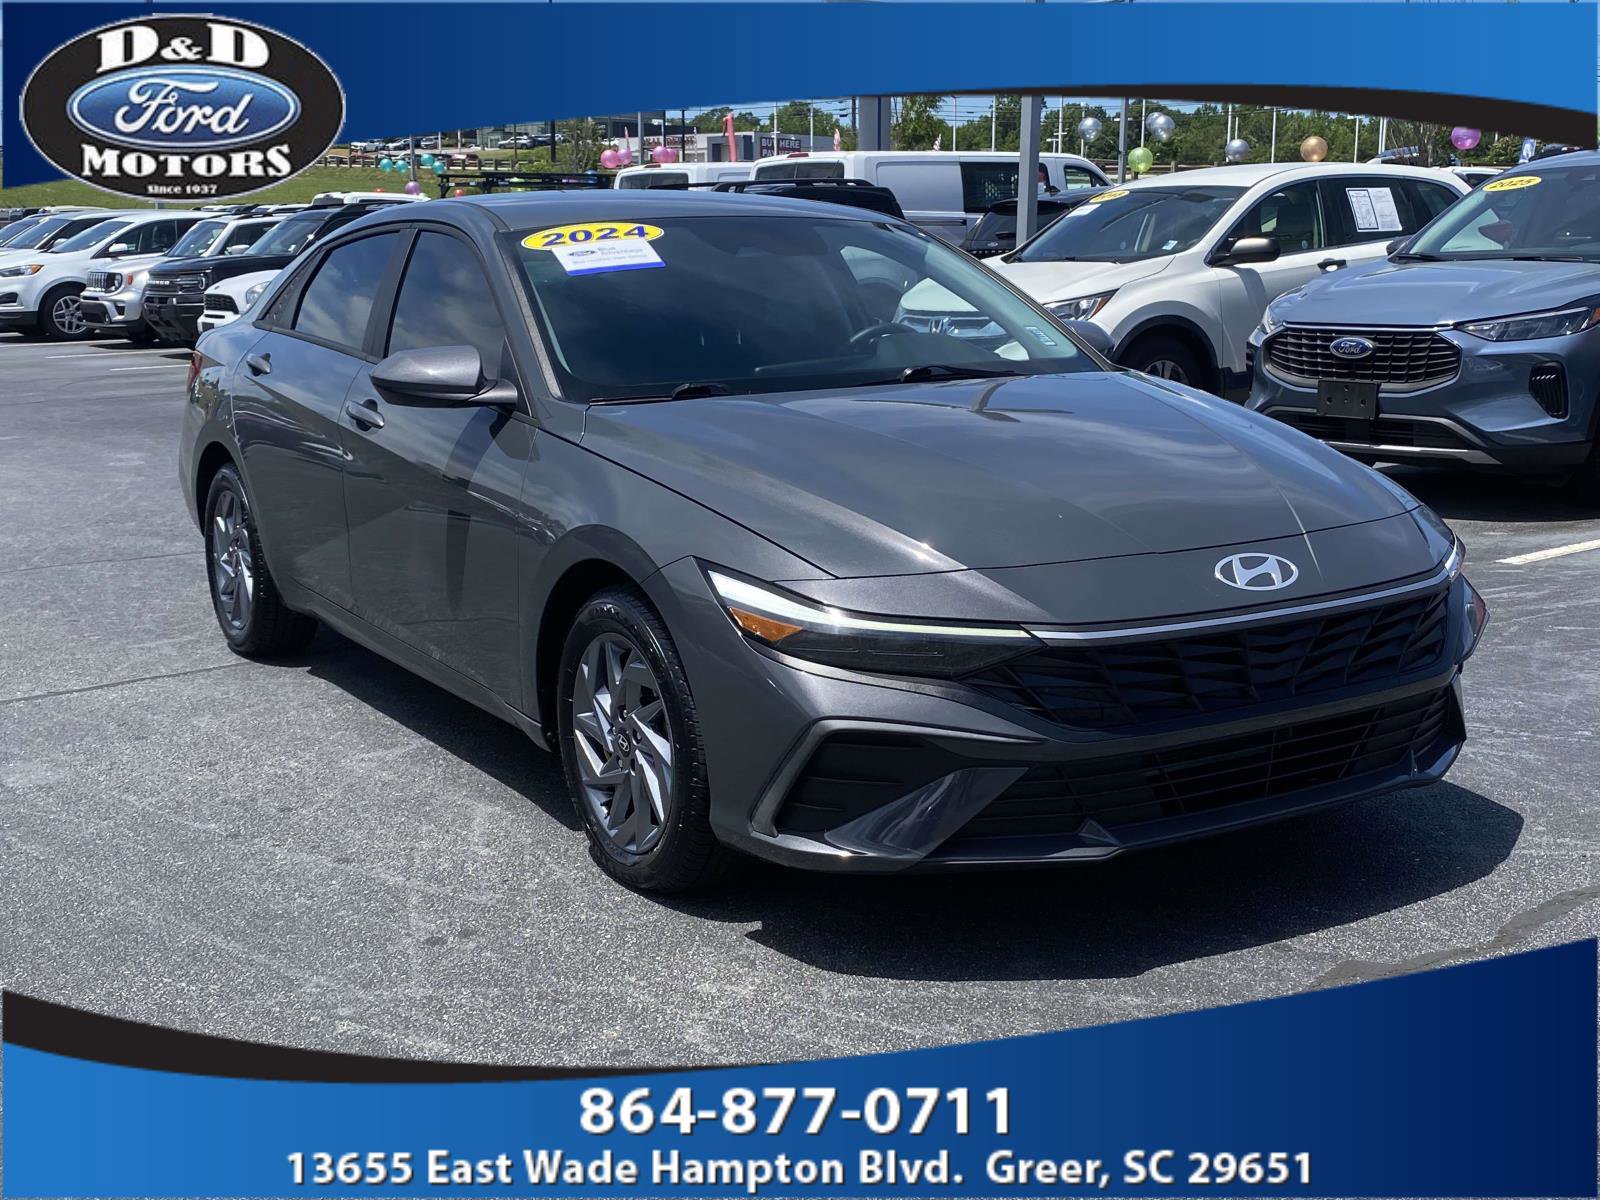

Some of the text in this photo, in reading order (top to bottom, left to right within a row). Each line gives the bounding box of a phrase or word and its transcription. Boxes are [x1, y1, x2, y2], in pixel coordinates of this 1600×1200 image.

[780, 140, 800, 149] HERE
[541, 225, 649, 248] 2024
[1338, 341, 1363, 354] Ford
